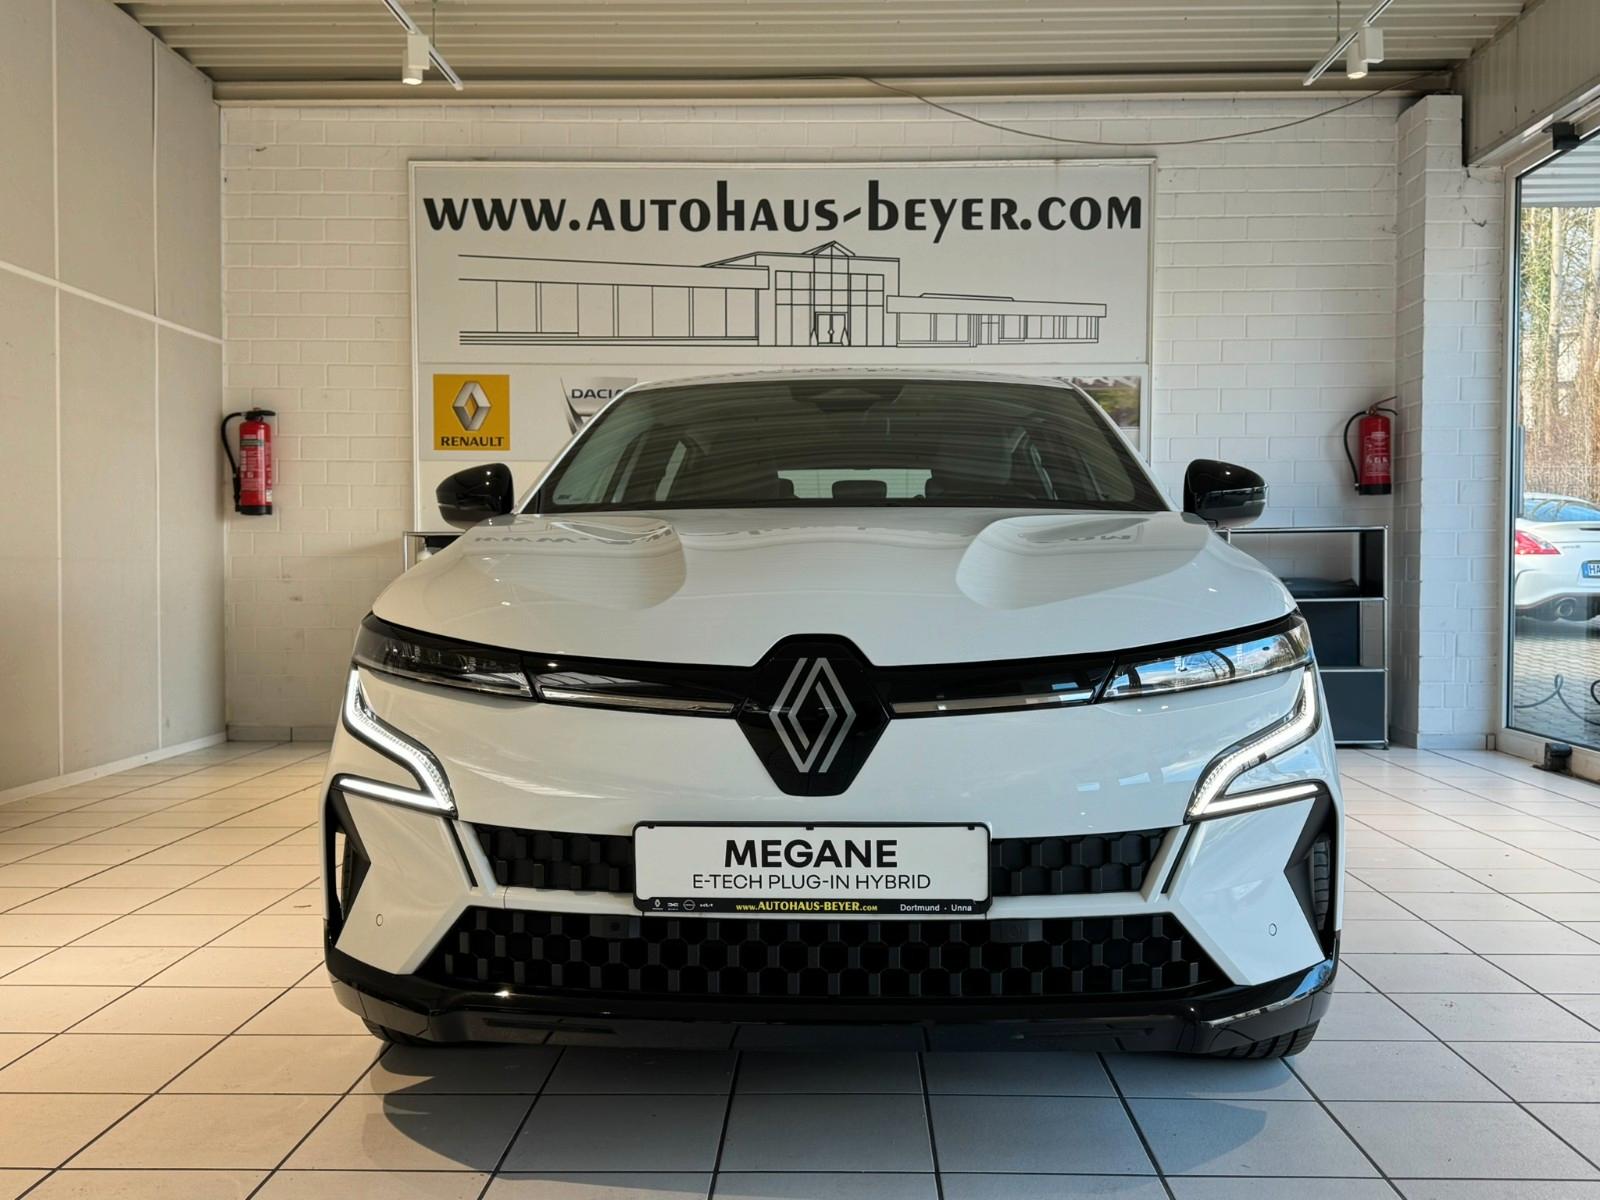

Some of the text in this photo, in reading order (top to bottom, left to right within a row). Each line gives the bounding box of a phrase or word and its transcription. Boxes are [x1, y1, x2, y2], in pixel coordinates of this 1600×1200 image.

[440, 436, 505, 447] RENAULT
[725, 839, 898, 868] MEGANE
[692, 874, 931, 890] E-TECH PLUG-IN HYBRID
[899, 903, 972, 912] Dortmund Unna
